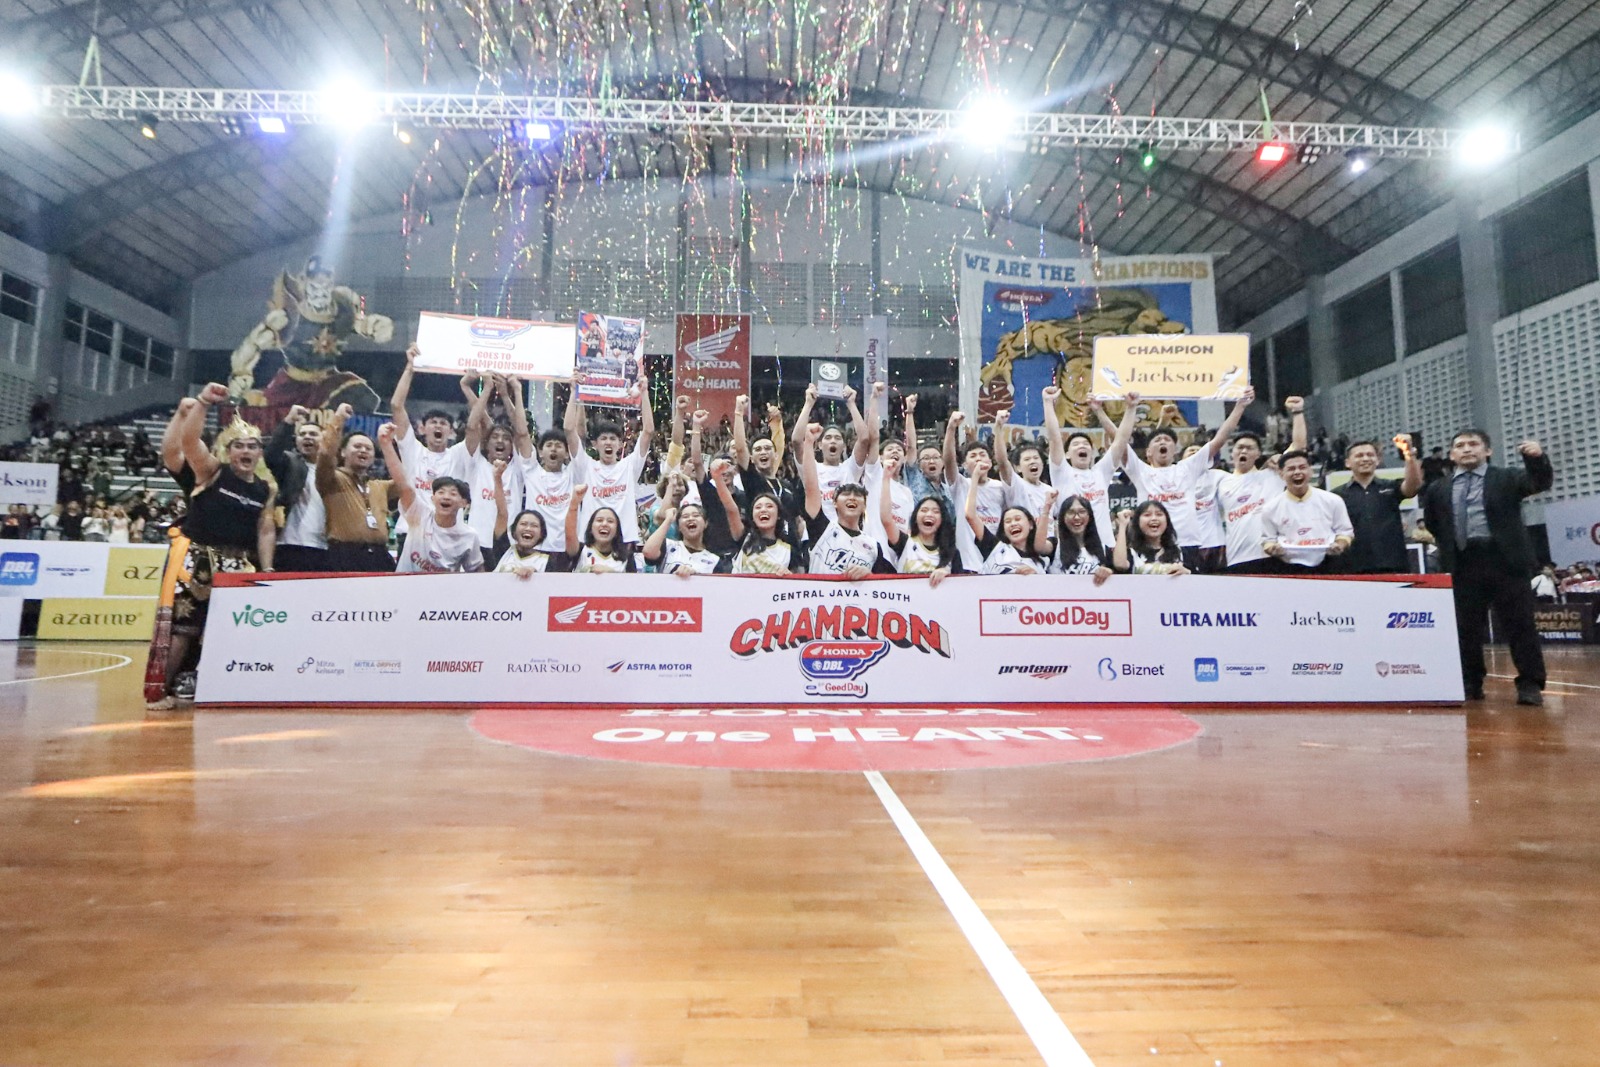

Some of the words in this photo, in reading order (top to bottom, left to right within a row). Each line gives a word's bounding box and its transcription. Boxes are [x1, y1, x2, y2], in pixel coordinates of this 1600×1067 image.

[963, 252, 990, 273] WE
[995, 259, 1032, 278] ARE
[1037, 262, 1076, 283] THE
[477, 351, 499, 360] GOES
[500, 352, 512, 361] TO
[1127, 345, 1214, 355] CHAMPION
[457, 357, 535, 372] CHAMPIONSHIP
[684, 360, 741, 369] HONDA
[1126, 367, 1214, 383] Jackson
[683, 378, 705, 389] One
[705, 378, 741, 389] HEART.
[0, 472, 47, 488] kson
[772, 590, 825, 602] CENTRAL
[829, 589, 860, 598] JAVA
[872, 590, 911, 603] SOUTH
[418, 610, 523, 622] AZAWEAR.COM
[586, 609, 696, 625] HONDA
[1018, 605, 1069, 626] Good
[1071, 605, 1110, 631] Day
[1160, 612, 1212, 627] ULTRA
[1216, 612, 1258, 627] MILK
[1290, 611, 1355, 626] Jackson
[729, 604, 950, 658] CHAMPION
[822, 648, 867, 656] HONDA
[238, 661, 274, 672] TikTok
[426, 660, 484, 673] MAINBASKET
[507, 663, 548, 673] RADAR
[550, 663, 582, 673] SOLO
[626, 663, 657, 671] ASTRA
[658, 663, 693, 671] MOTOR
[821, 660, 845, 671] DBL
[998, 663, 1069, 675] proteam
[1122, 663, 1165, 676] Biznet
[825, 682, 847, 692] Good
[847, 682, 864, 694] Day
[619, 708, 1038, 717] HONDA
[592, 727, 771, 743] One
[792, 726, 1104, 743] HEART.
